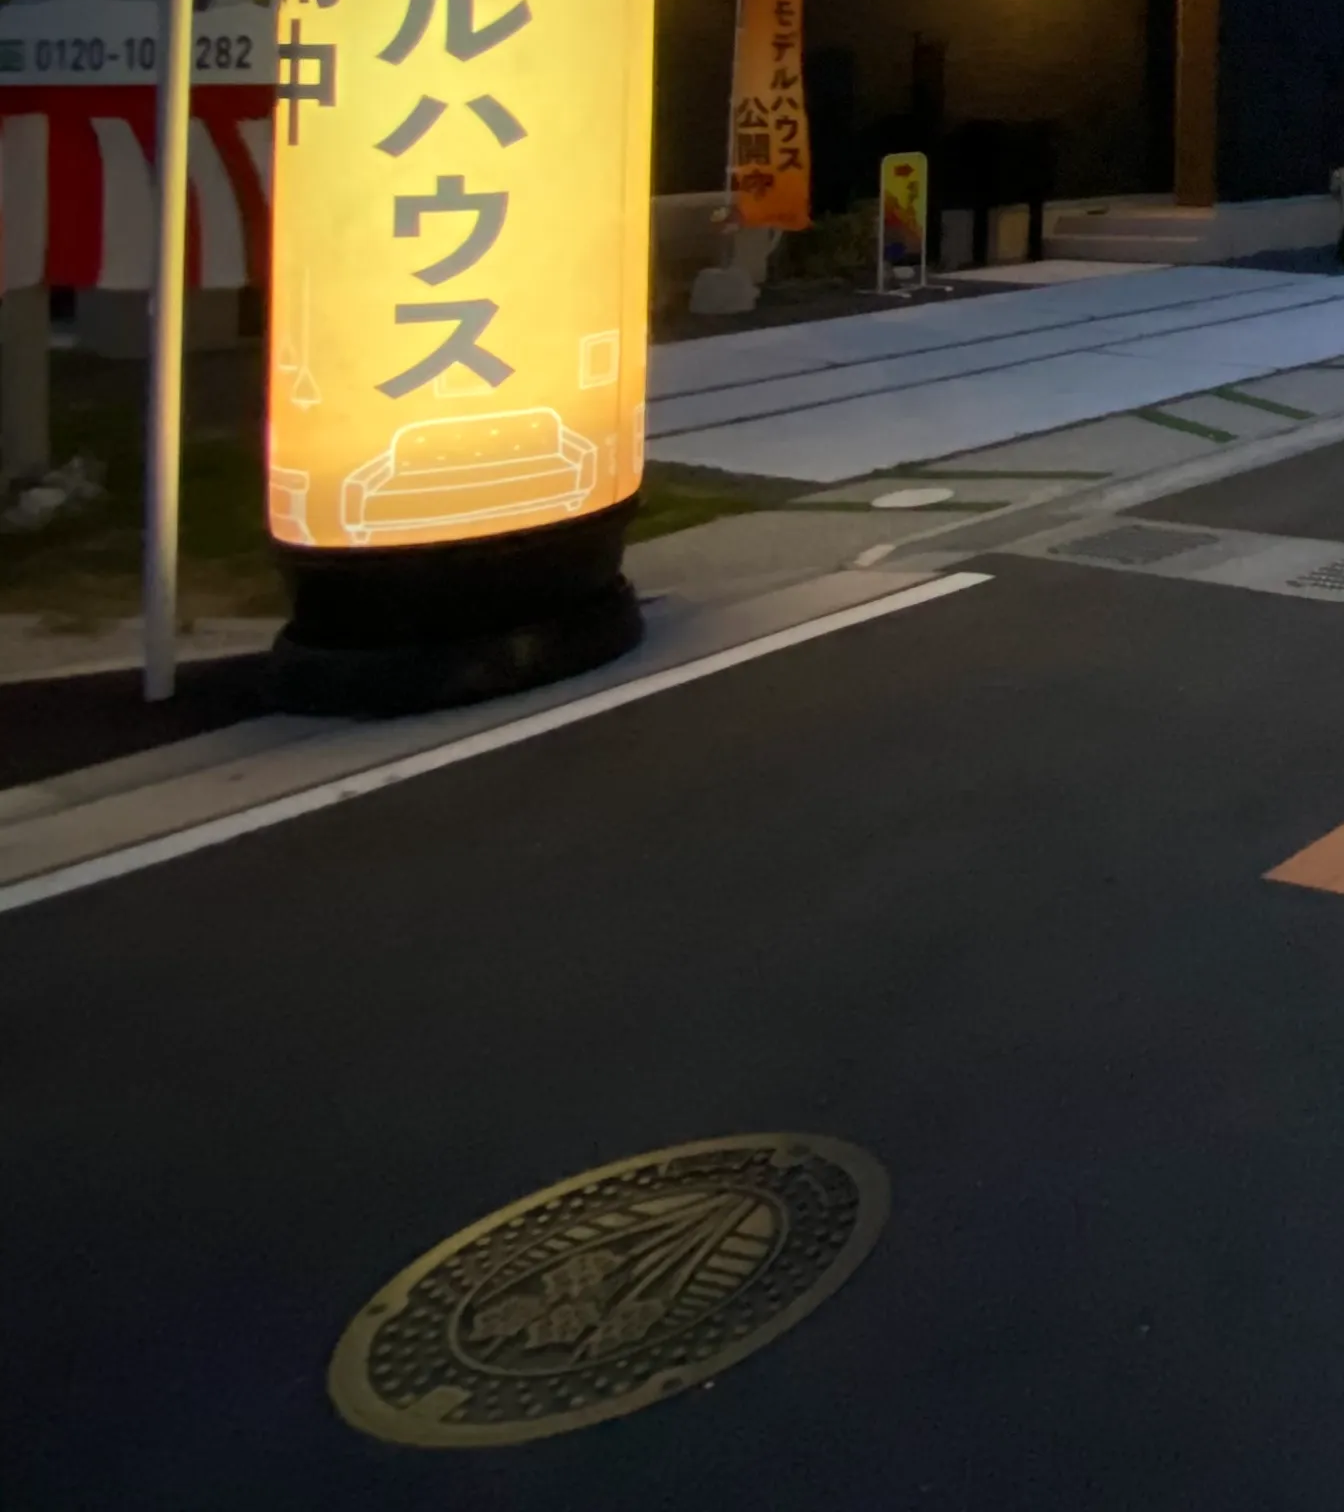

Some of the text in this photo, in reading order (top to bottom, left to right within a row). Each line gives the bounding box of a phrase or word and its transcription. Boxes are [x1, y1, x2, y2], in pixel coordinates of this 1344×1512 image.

[34, 35, 253, 72] 0120-10282
[769, 0, 804, 172] モデルハウス
